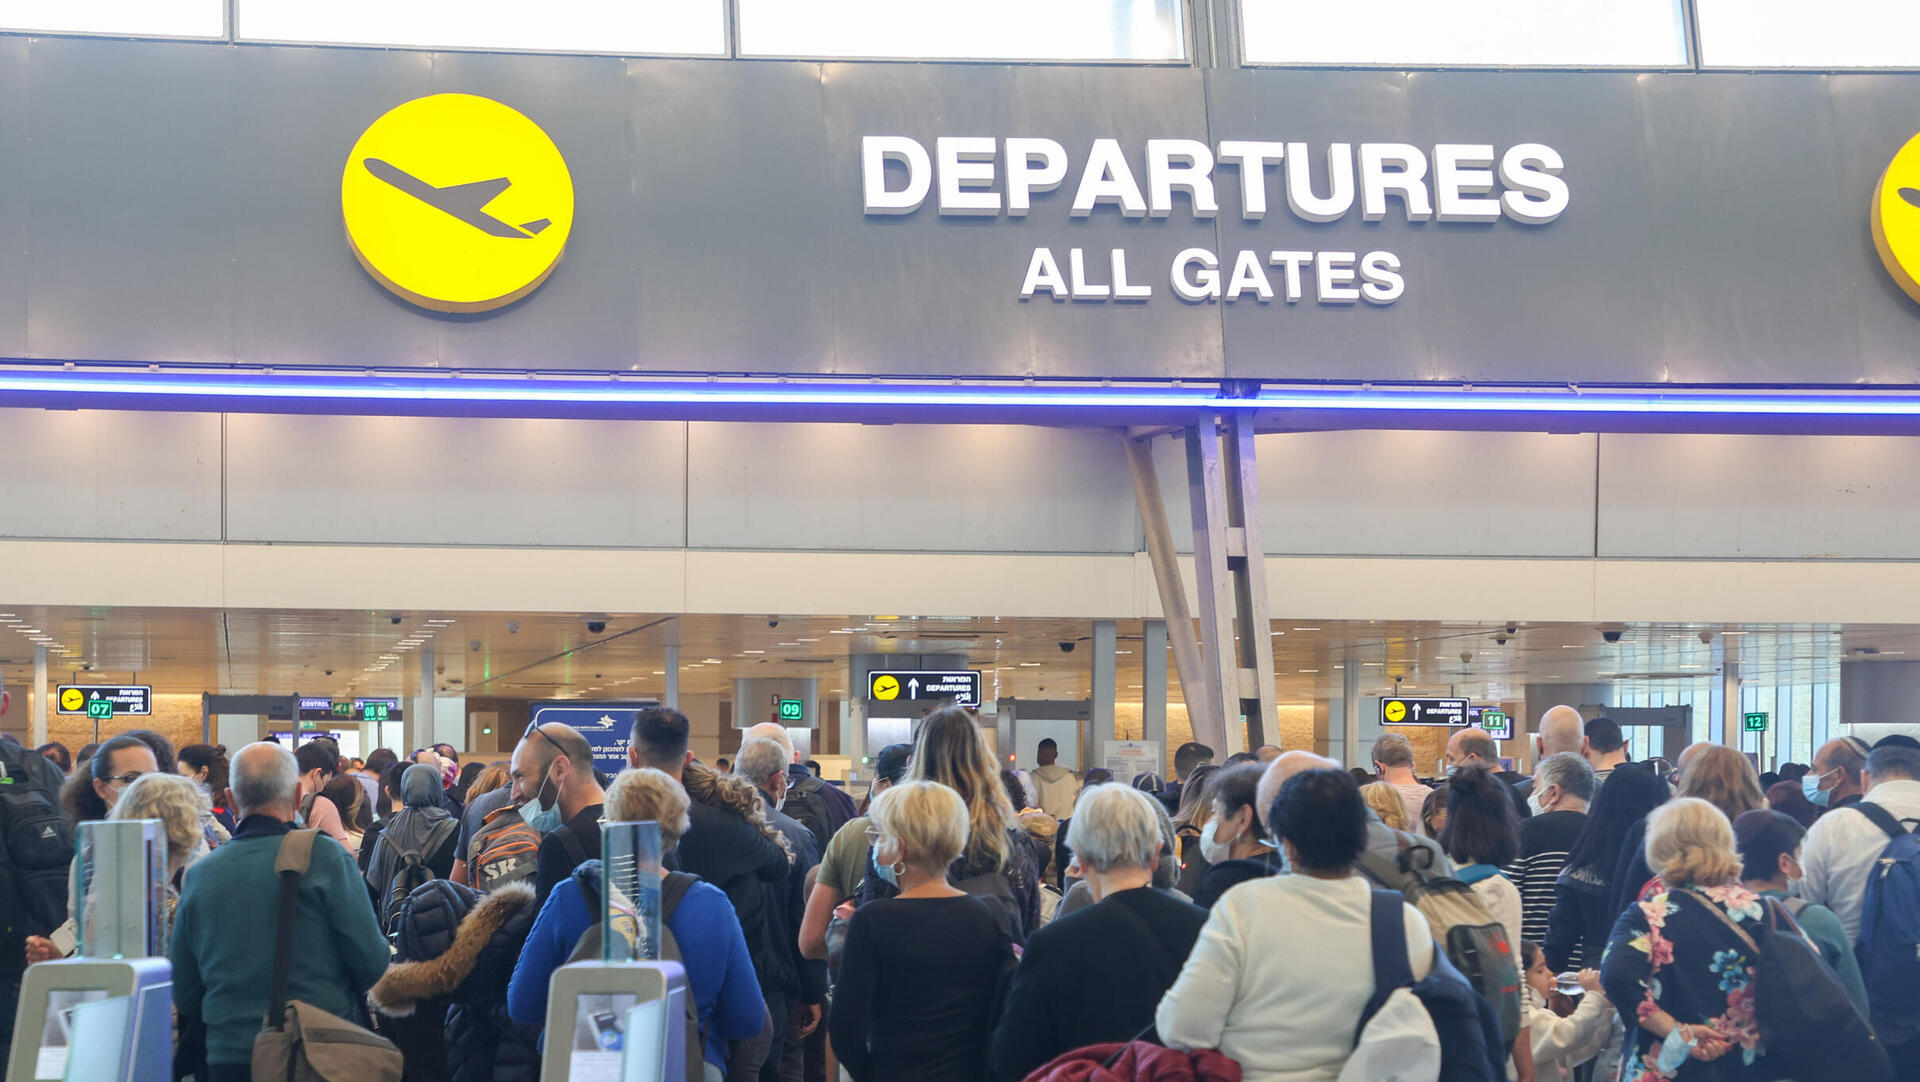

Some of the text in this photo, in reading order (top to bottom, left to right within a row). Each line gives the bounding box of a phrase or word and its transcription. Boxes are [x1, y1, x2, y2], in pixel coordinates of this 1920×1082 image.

[862, 135, 1569, 223] DEPARTURES
[1020, 247, 1405, 303] ALL GATES
[926, 684, 971, 692] DEPARTURES
[91, 703, 109, 715] 07
[782, 703, 800, 715] 09
[1487, 716, 1501, 726] 11
[1748, 716, 1762, 727] 12
